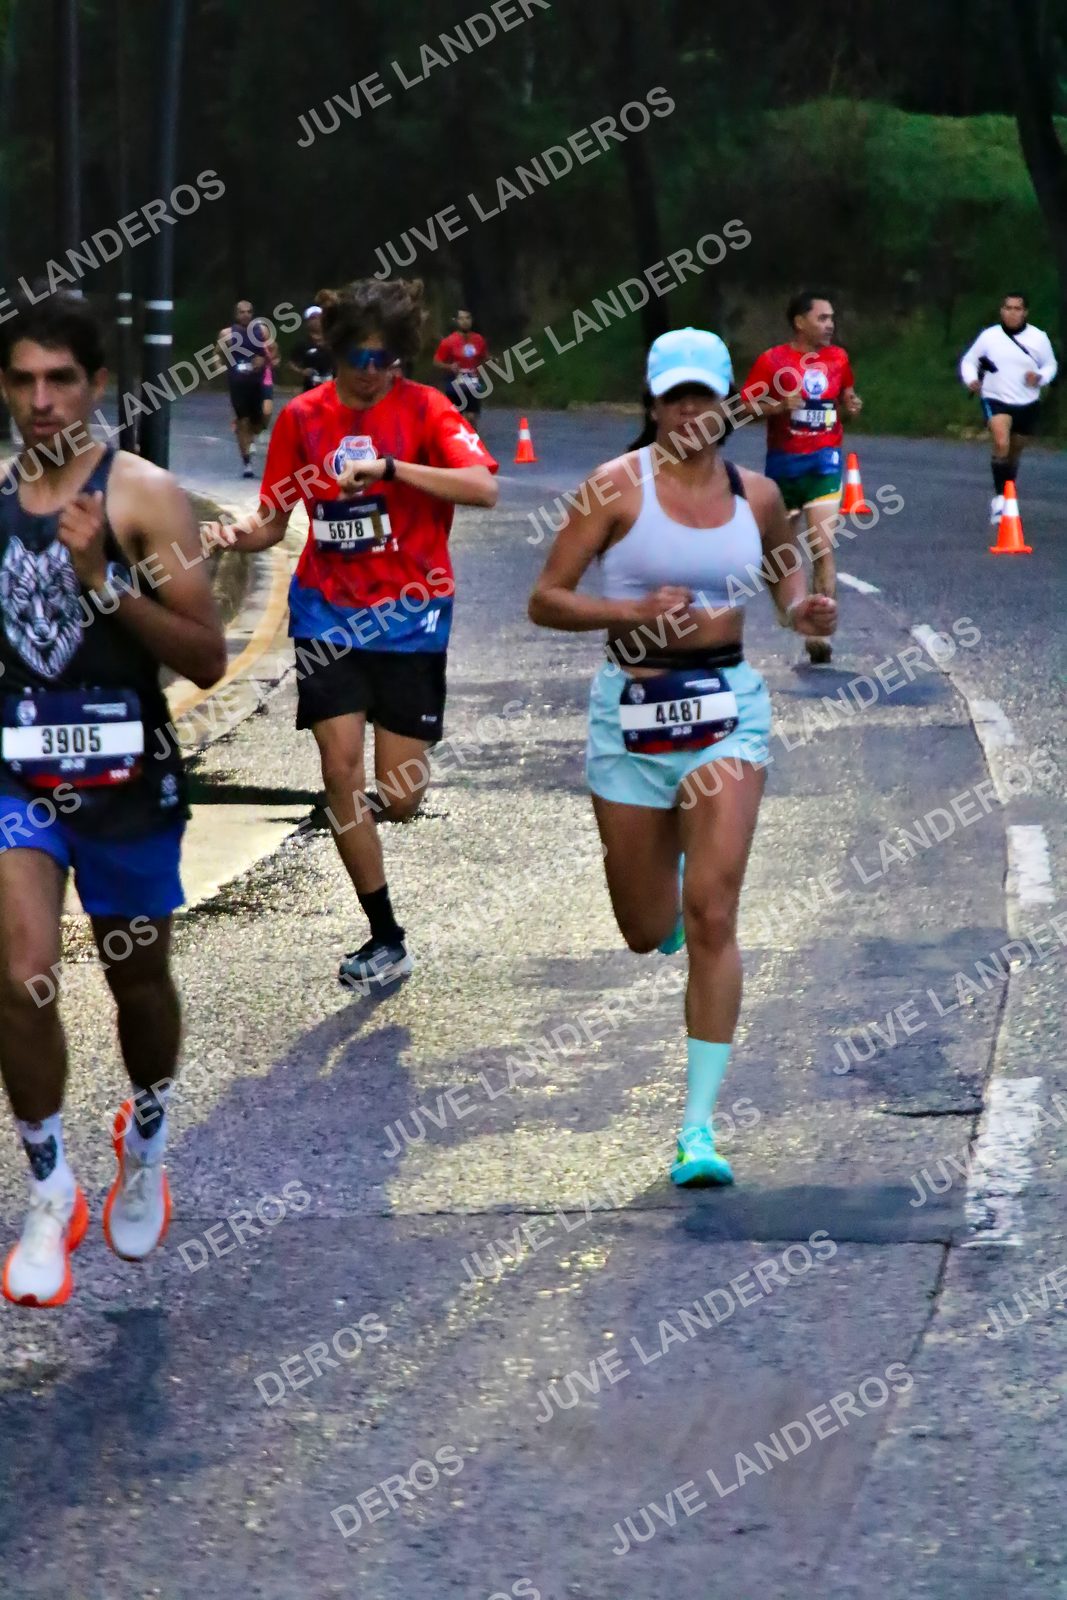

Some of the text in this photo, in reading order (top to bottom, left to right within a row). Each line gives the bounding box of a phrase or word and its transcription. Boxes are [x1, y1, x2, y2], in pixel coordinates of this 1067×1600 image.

[328, 520, 365, 540] 5678
[655, 699, 703, 725] 4487
[41, 727, 102, 755] 3905
